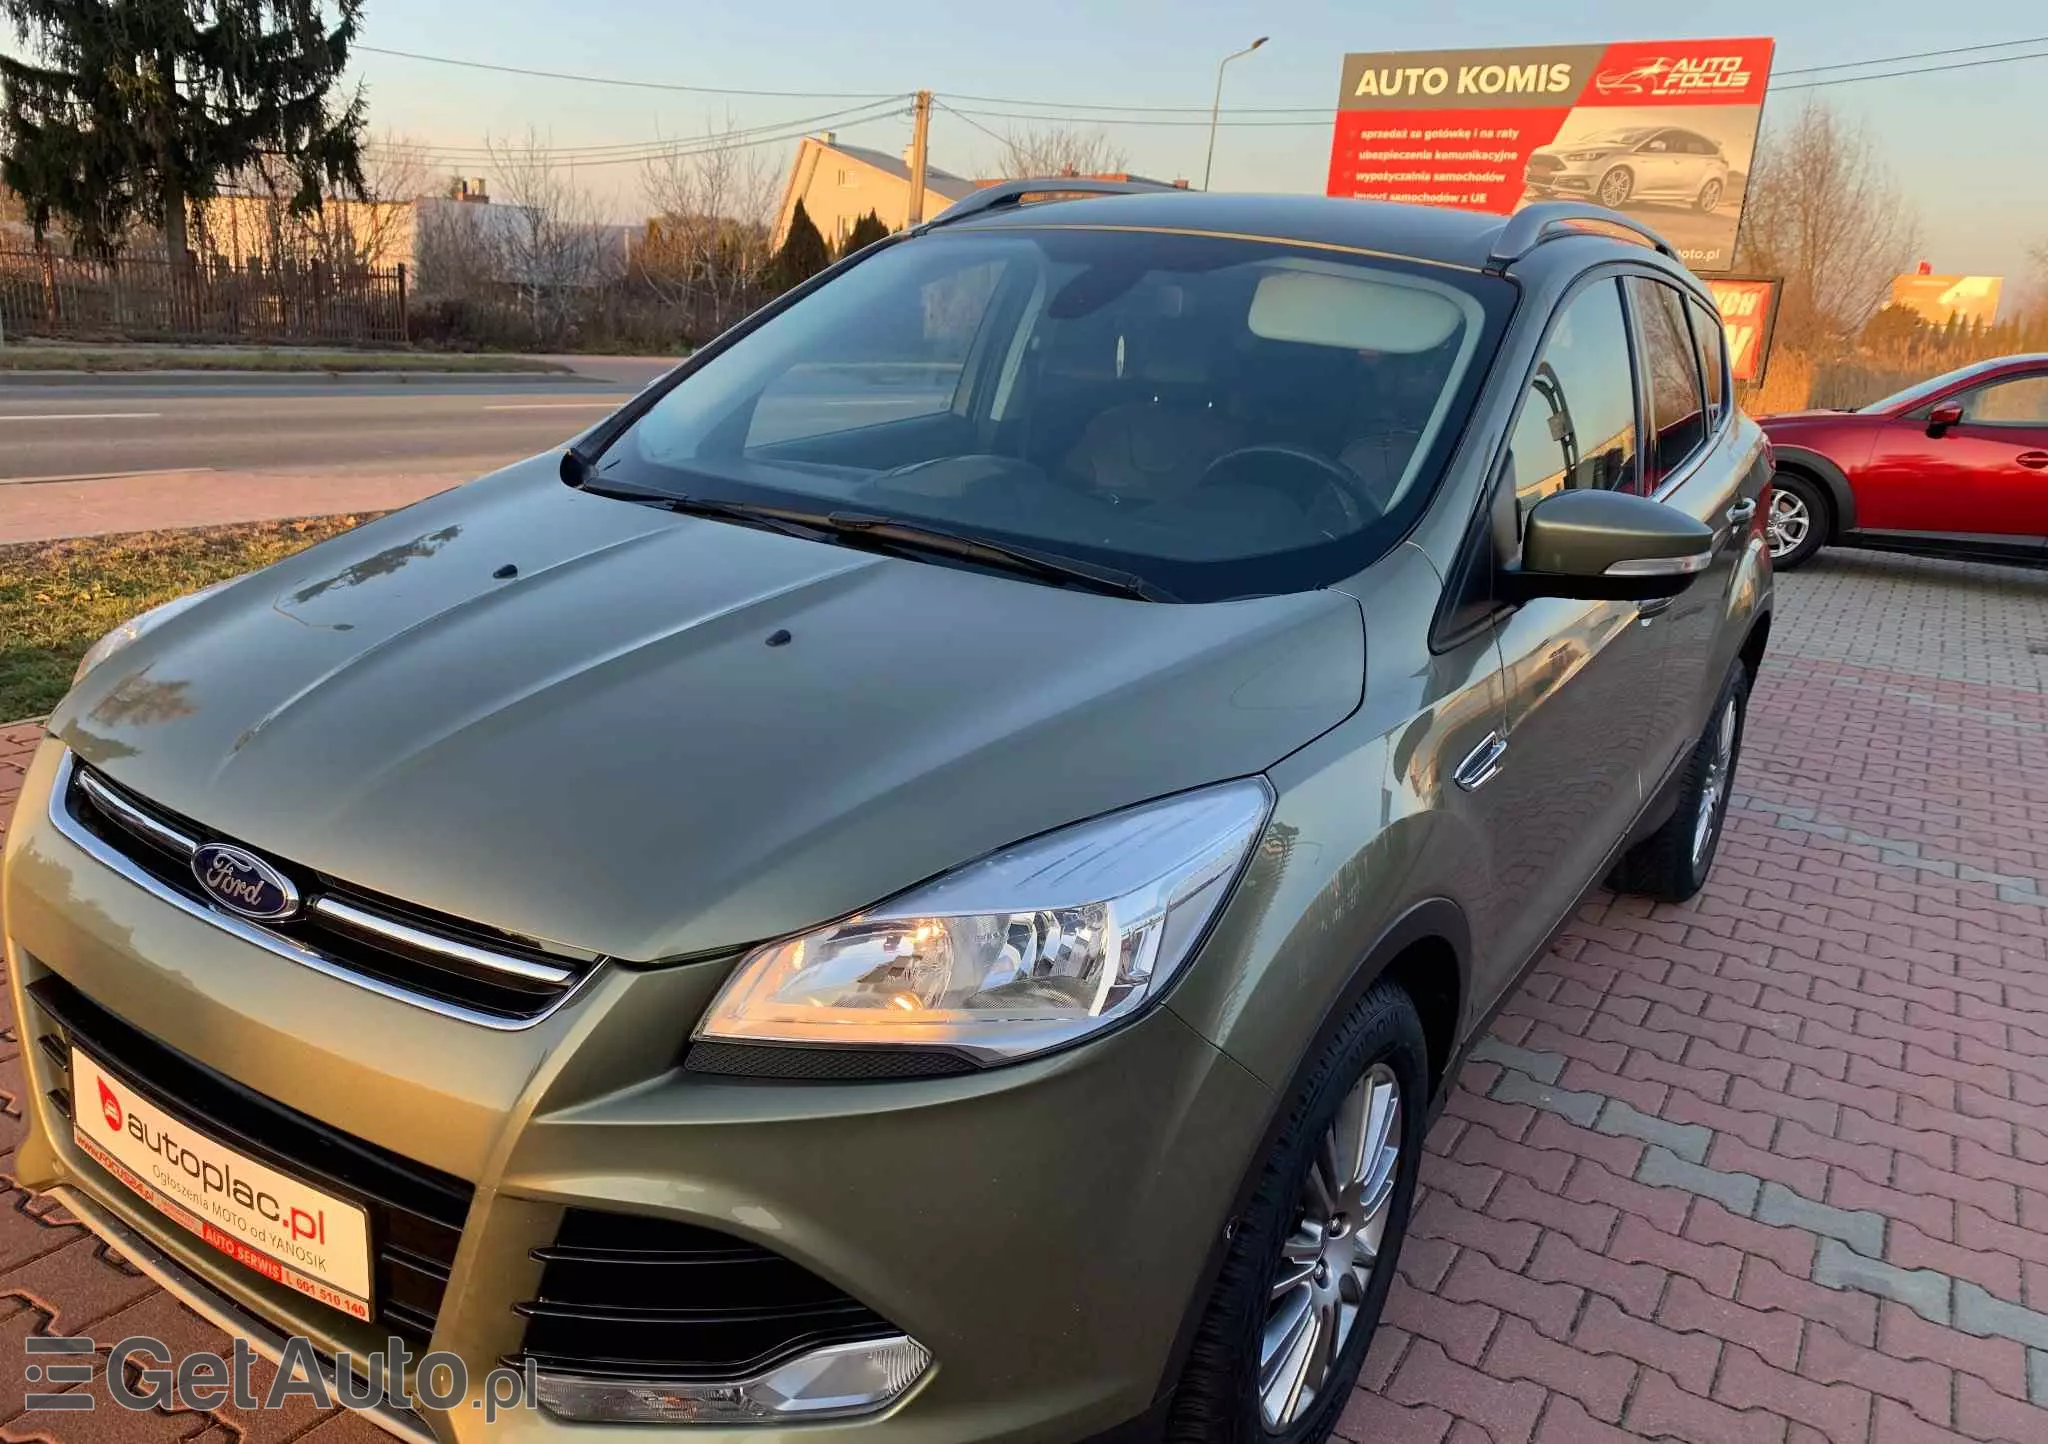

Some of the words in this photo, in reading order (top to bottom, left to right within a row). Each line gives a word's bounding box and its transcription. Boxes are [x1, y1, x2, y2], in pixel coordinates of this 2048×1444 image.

[1671, 56, 1743, 73] AUTO
[1355, 67, 1449, 96] AUTO
[1456, 63, 1572, 94] KOMIS
[1663, 71, 1752, 88] FOCUS
[1480, 129, 1495, 138] na
[1496, 127, 1520, 140] raty
[1435, 149, 1518, 163] komunikacyjne
[1433, 171, 1506, 182] samochodów
[1389, 192, 1459, 203] samochodów
[1470, 192, 1487, 204] UE
[206, 853, 265, 905] Ford
[128, 1113, 325, 1245] autoplac.pl
[152, 1164, 210, 1210] Ogłoszenia
[212, 1201, 248, 1232] MOTO
[250, 1224, 267, 1242] od
[269, 1232, 328, 1273] YANOSIK
[205, 1227, 235, 1256] AUTO
[237, 1248, 281, 1279] SERWIS
